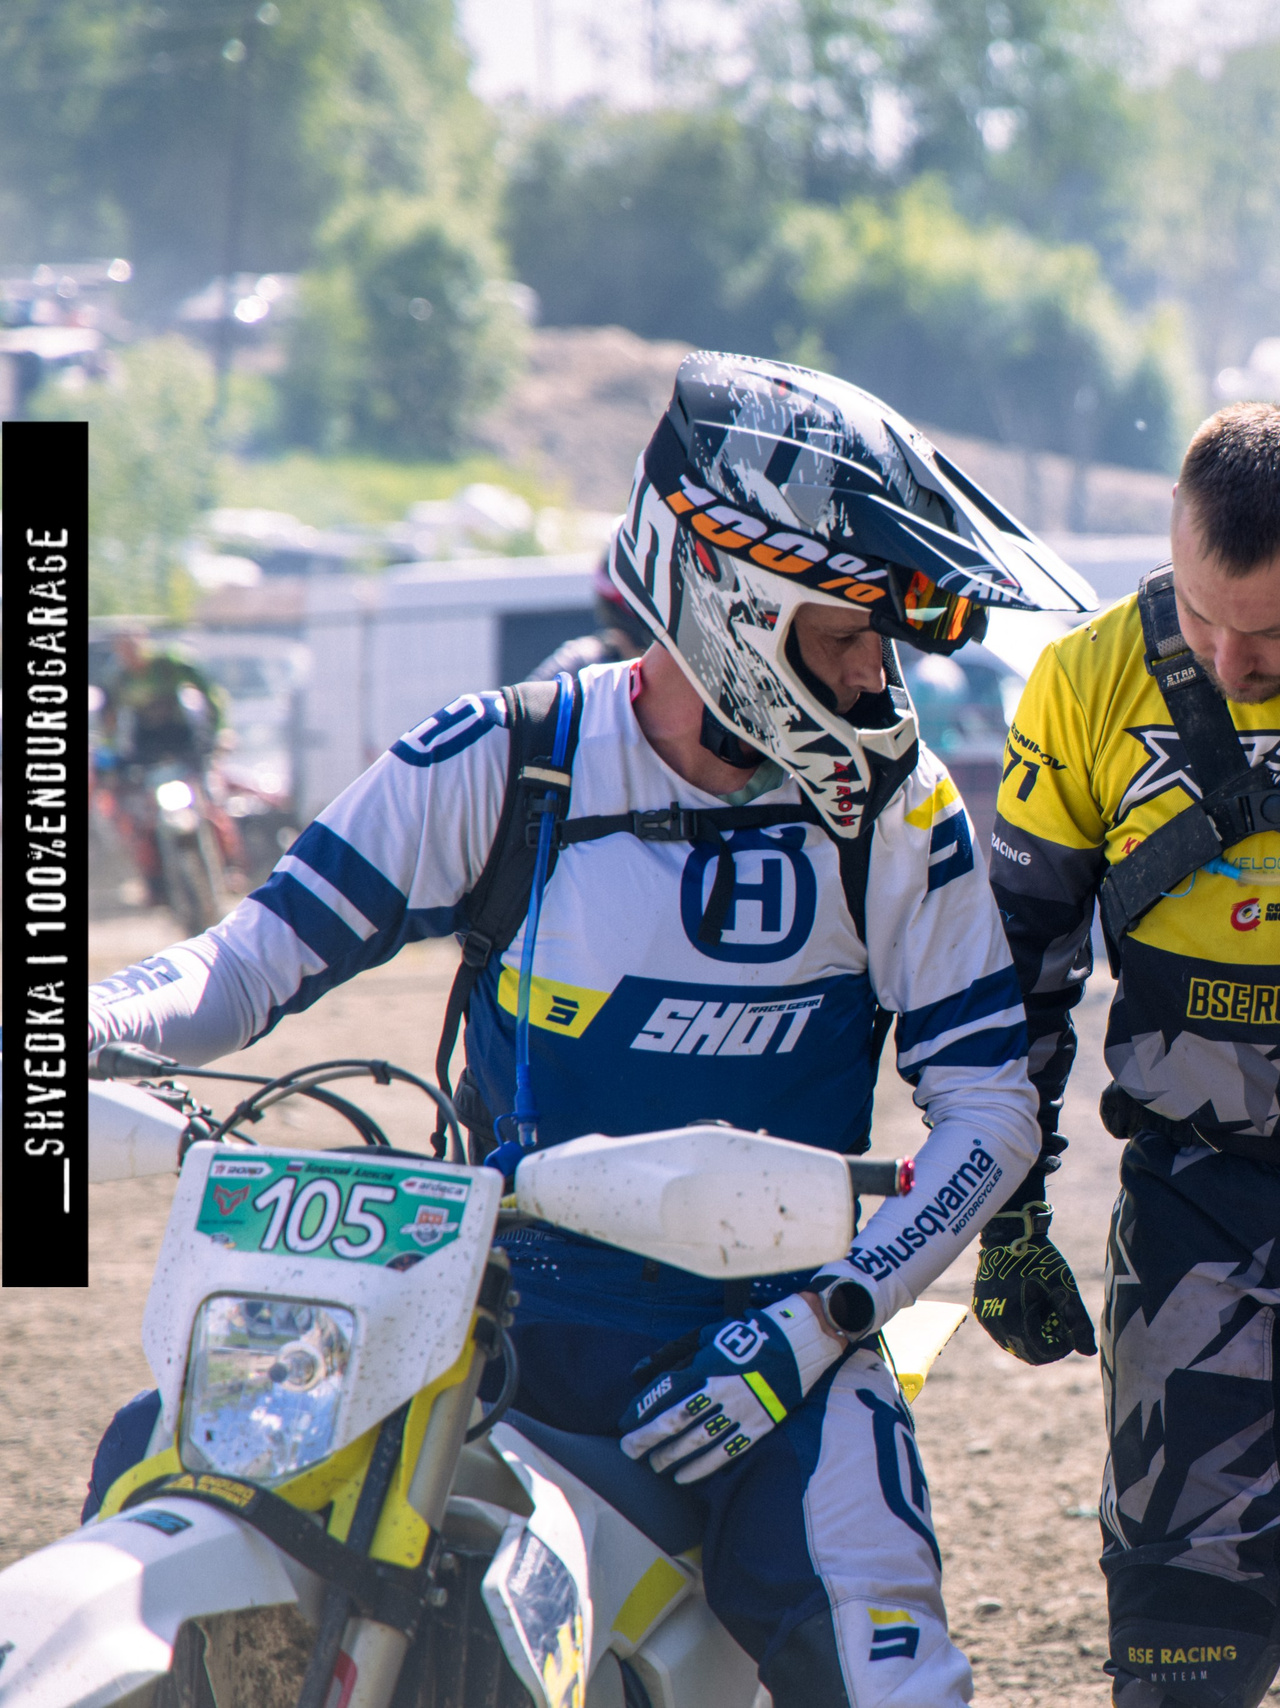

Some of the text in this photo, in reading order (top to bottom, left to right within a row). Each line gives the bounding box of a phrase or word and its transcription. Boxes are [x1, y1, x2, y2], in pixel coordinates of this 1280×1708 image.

[833, 760, 856, 828] AIROH
[629, 993, 826, 1057] SHOT
[748, 998, 822, 1014] RACE GEAR
[251, 1173, 397, 1260] 105
[860, 1147, 995, 1278] Husqvarna
[951, 1167, 1003, 1237] MOTORCYCLES
[636, 1375, 673, 1419] SHOT
[1128, 1645, 1238, 1665] BSE RACING
[1171, 1669, 1208, 1682] TEAM
